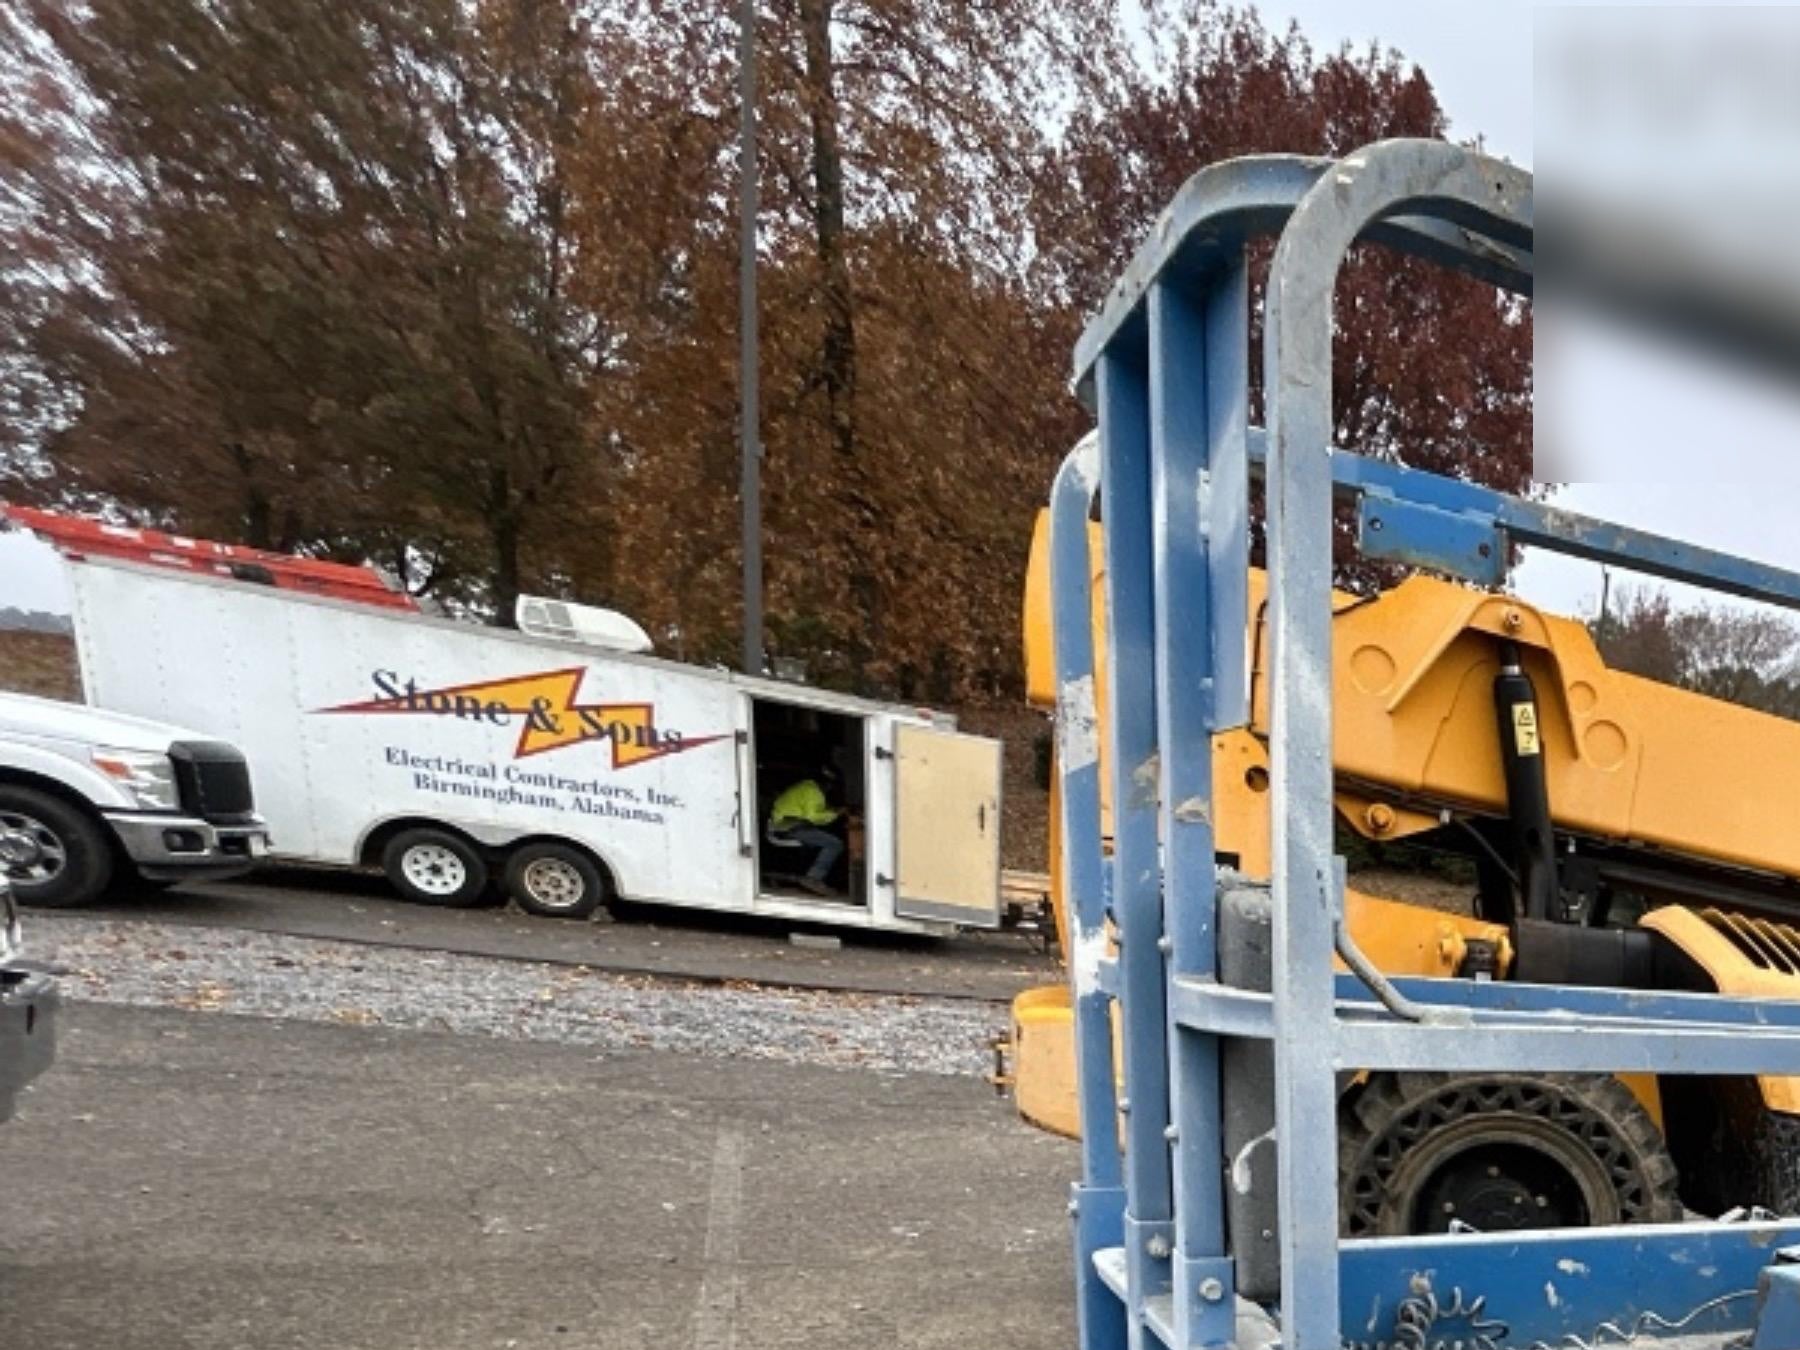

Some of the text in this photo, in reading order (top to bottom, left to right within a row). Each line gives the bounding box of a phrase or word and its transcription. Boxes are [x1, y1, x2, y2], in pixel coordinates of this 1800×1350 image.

[372, 669, 682, 753] Stone & Sons
[385, 747, 686, 808] Electrical Contractors, Inc.
[413, 774, 665, 825] Birmingham, Alabama
